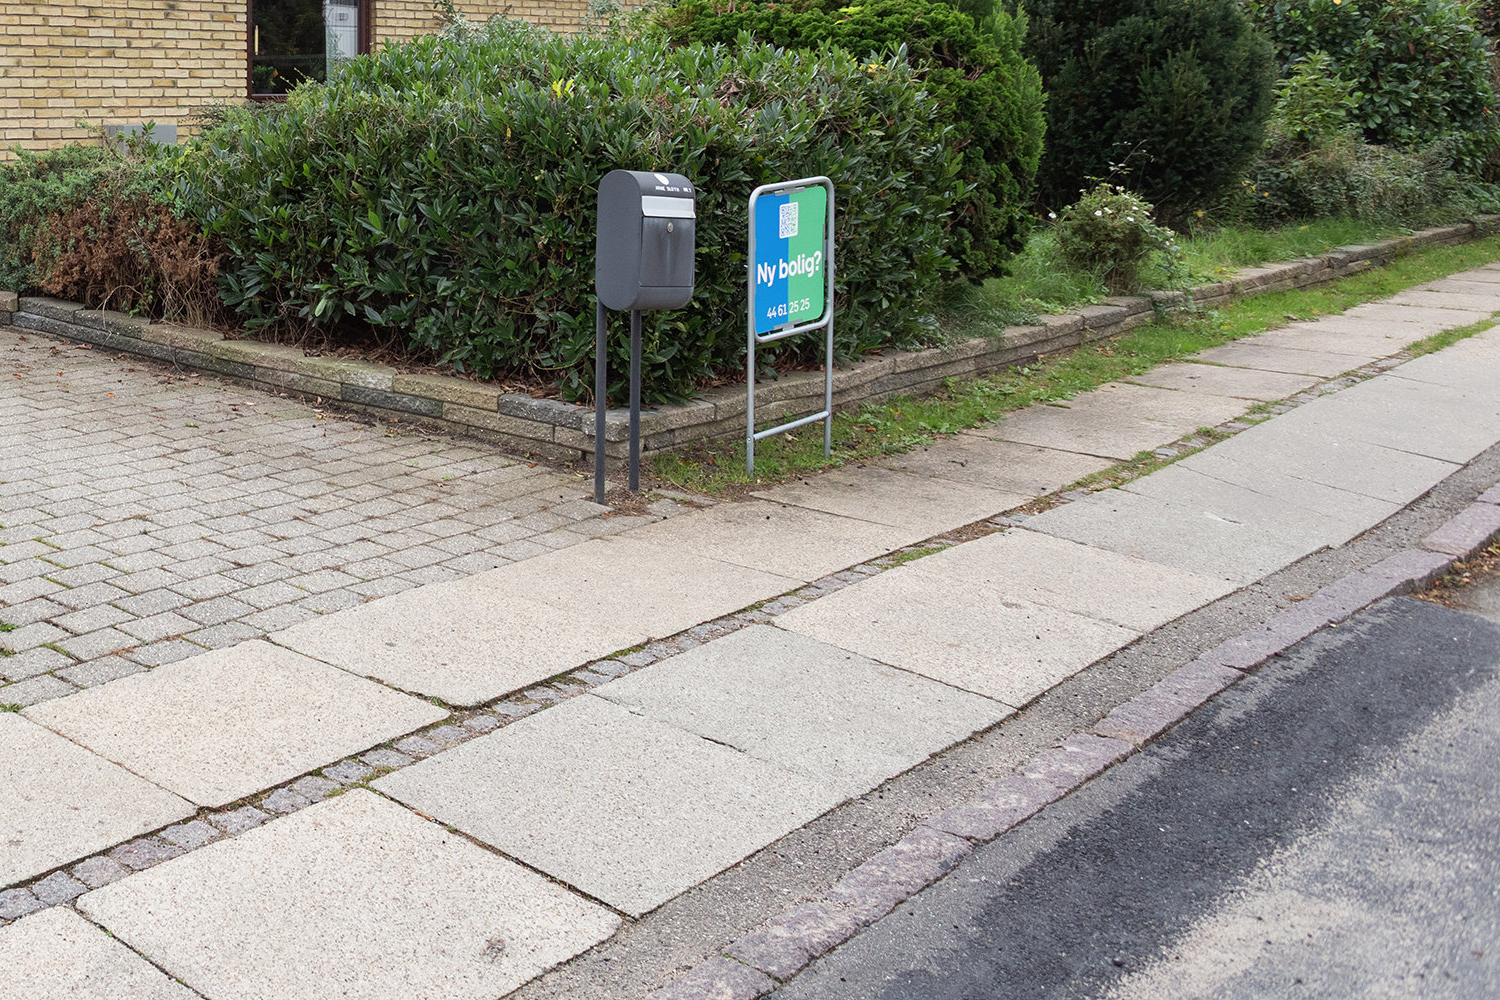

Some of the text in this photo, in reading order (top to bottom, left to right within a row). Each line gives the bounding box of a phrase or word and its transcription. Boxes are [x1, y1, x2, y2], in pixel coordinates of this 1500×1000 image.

[757, 250, 822, 287] Ny bolig?
[766, 297, 810, 319] 44 61 25 25
